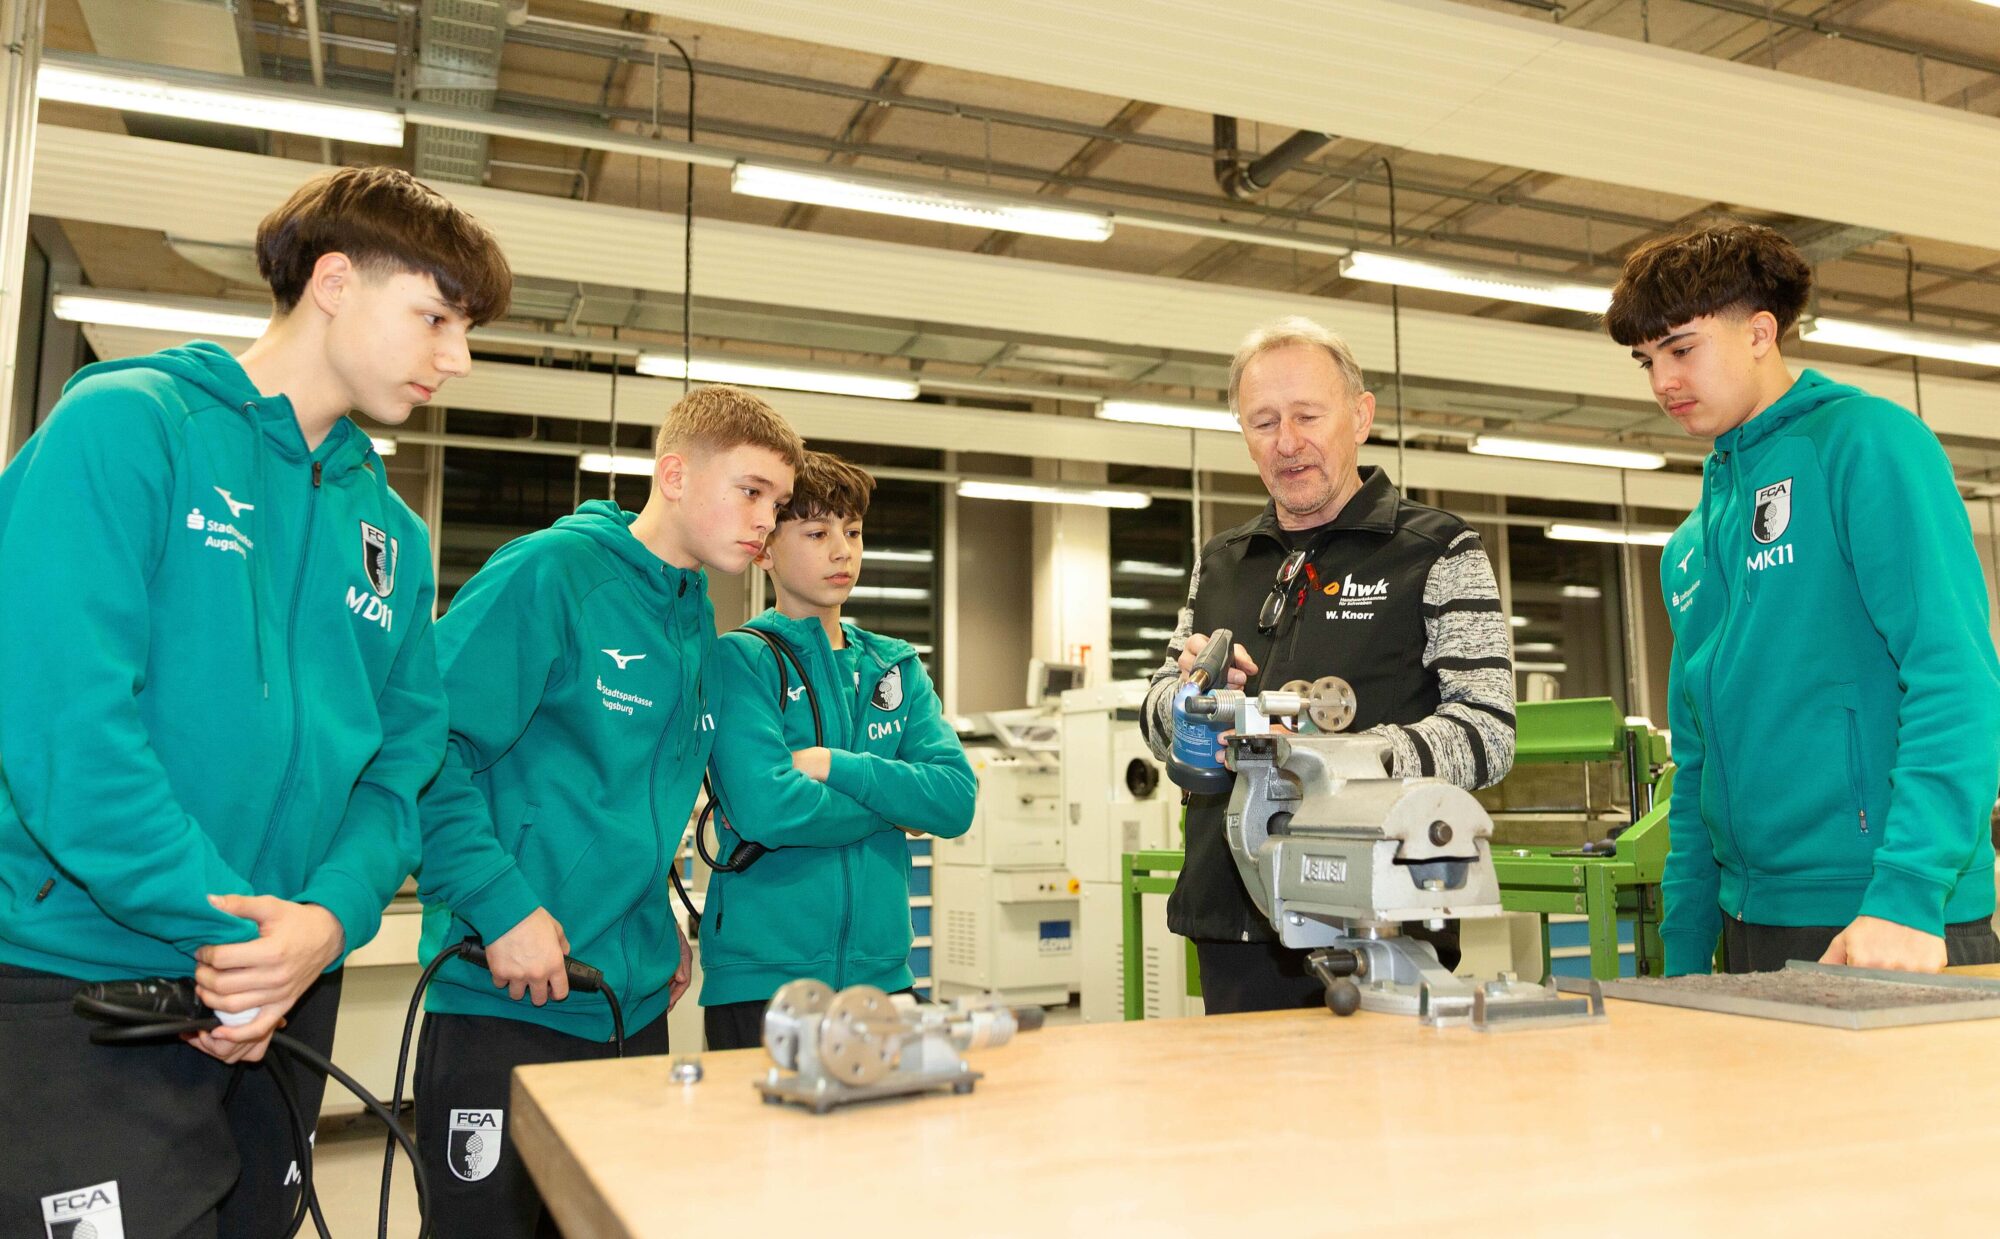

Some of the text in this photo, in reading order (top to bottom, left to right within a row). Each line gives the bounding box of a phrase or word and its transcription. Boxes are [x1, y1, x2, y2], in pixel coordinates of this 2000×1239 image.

[1760, 483, 1787, 500] FCA
[1746, 543, 1794, 574] MK11
[1341, 573, 1390, 597] hwk
[345, 585, 393, 632] MD11
[1326, 610, 1375, 620] W. Knorr
[602, 685, 653, 707] Stadtsparkasse
[867, 716, 907, 740] CM1
[456, 1112, 497, 1128] FCA
[52, 1188, 112, 1213] FCA
